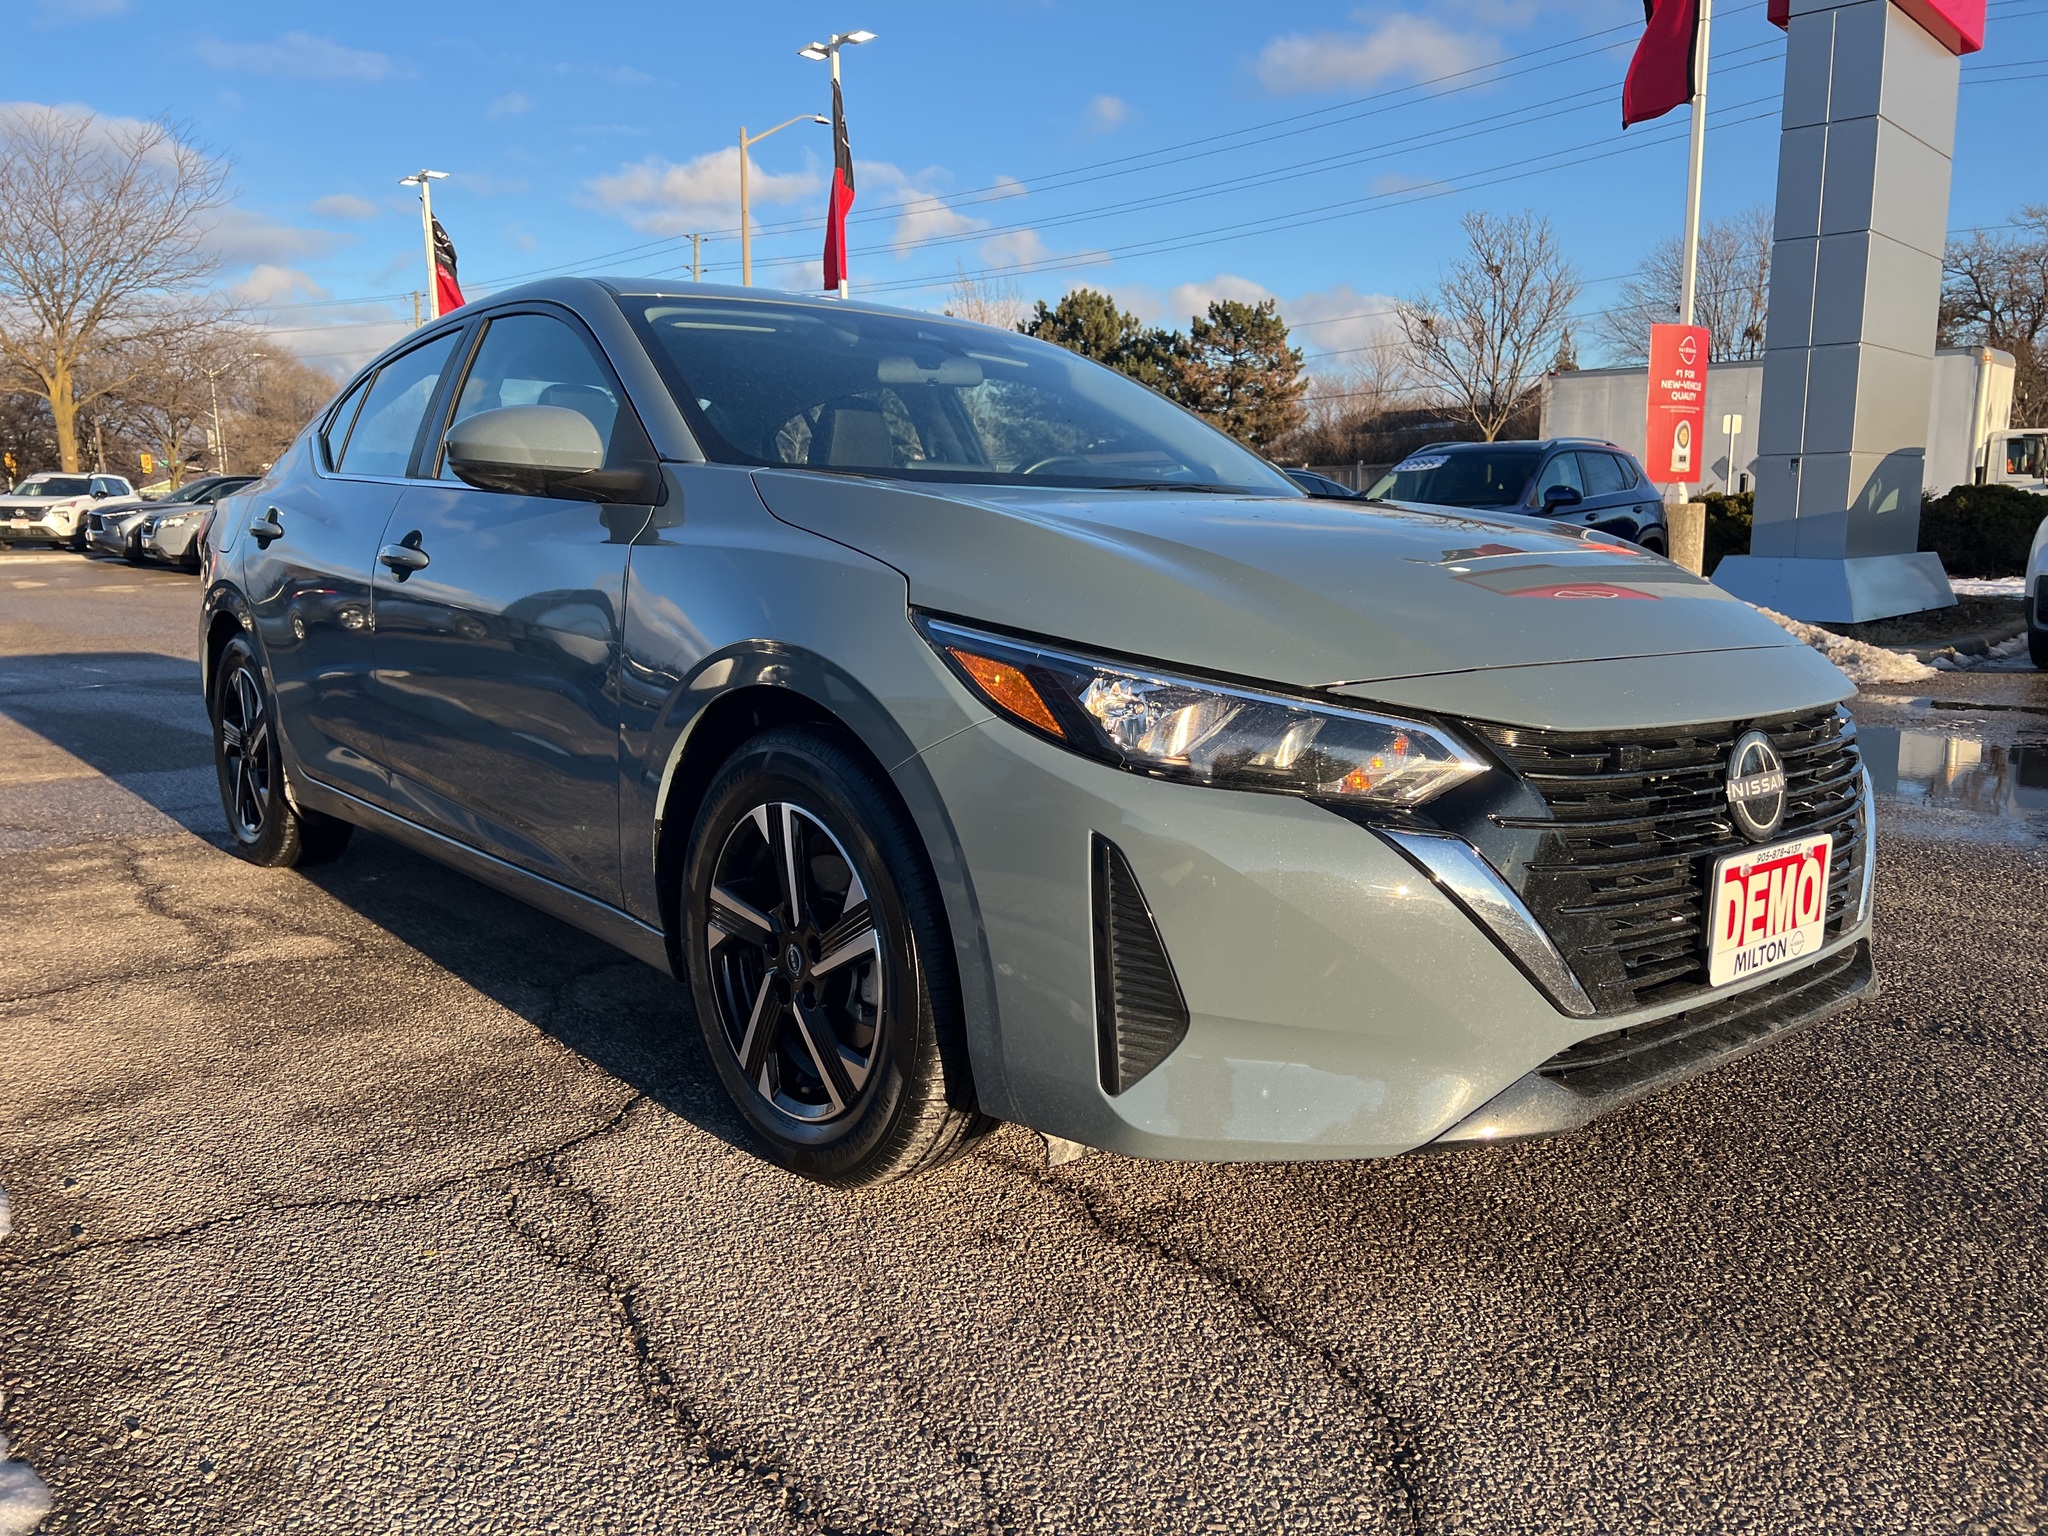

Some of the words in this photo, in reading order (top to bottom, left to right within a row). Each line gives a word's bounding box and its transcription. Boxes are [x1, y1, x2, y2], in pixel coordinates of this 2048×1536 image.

[1676, 369, 1683, 378] #1
[1684, 370, 1695, 379] FOR
[1661, 380, 1701, 391] NEW-VEHICLE
[1671, 391, 1696, 400] QUALITY
[1731, 773, 1785, 797] NISSAN
[1756, 843, 1802, 863] 905-878-4137
[1721, 857, 1821, 947] DEMO
[1734, 937, 1787, 975] MILTON
